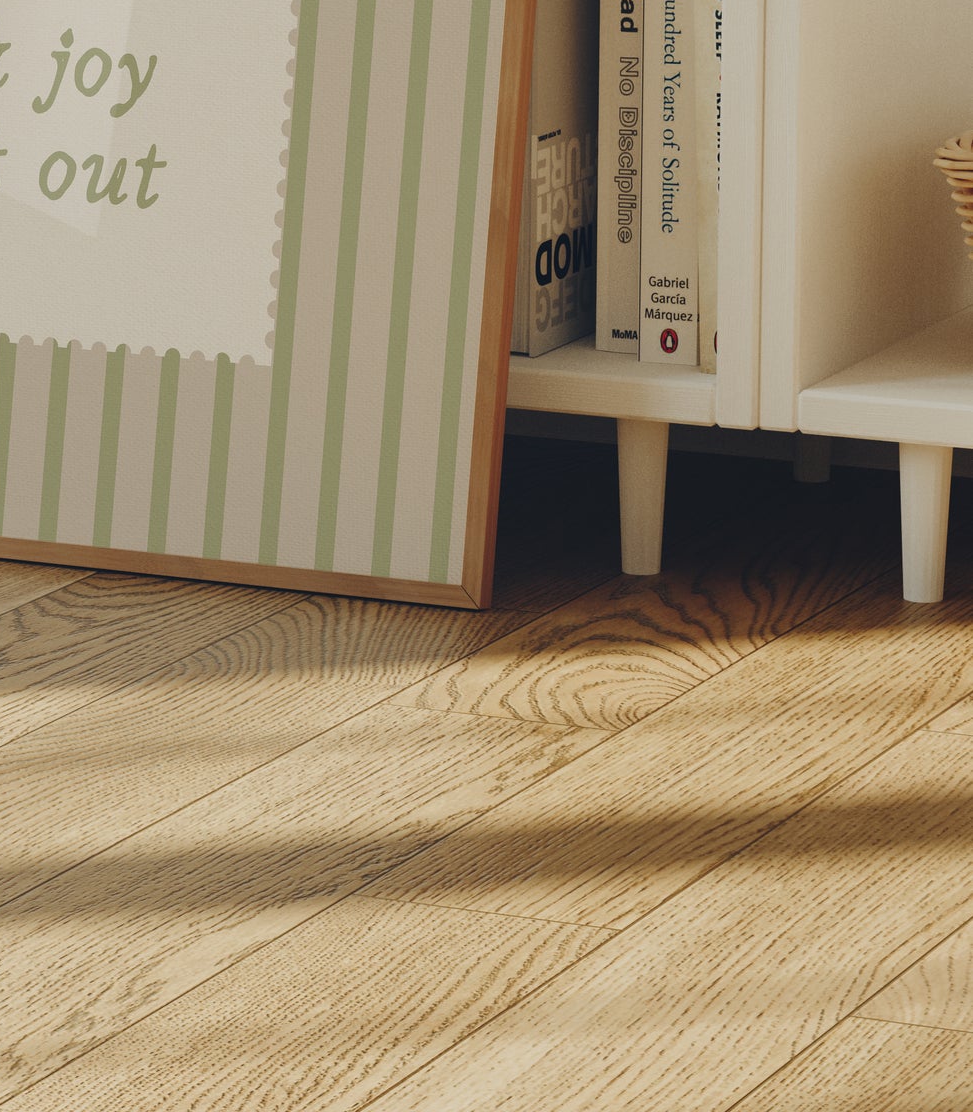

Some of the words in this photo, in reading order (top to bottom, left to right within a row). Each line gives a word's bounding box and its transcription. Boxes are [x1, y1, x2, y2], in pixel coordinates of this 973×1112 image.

[31, 28, 158, 118] joy
[619, 57, 639, 96] No
[663, 71, 681, 122] Years
[662, 128, 680, 151] of
[38, 143, 167, 209] out
[614, 107, 639, 244] Discipline
[661, 158, 680, 234] Solitude
[535, 226, 594, 286] MOD
[648, 276, 689, 289] Gabriel
[651, 292, 686, 305] García
[611, 329, 638, 340] MoMA
[644, 308, 693, 323] Márquez
